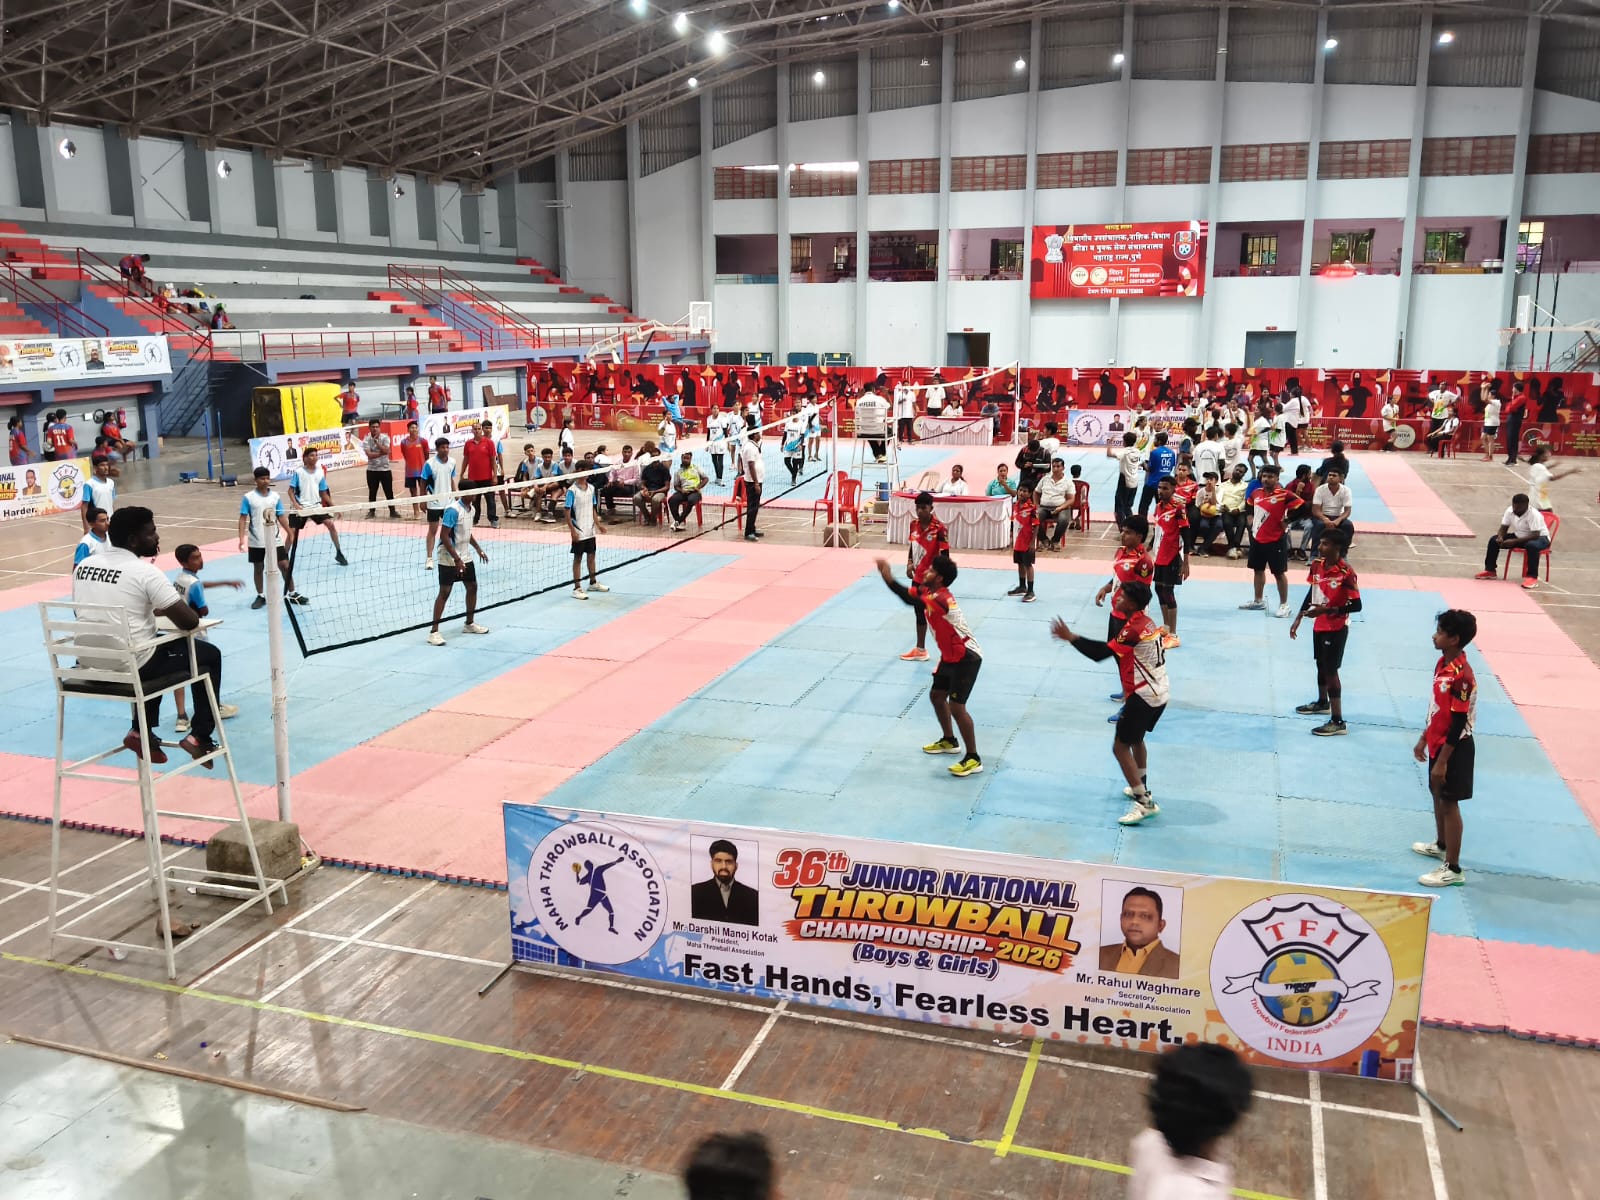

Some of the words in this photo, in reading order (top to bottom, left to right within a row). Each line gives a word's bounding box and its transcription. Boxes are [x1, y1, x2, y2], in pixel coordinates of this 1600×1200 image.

[1161, 457, 1172, 467] 06
[3, 507, 37, 517] Harder.
[76, 566, 122, 584] REFEREE
[540, 832, 616, 881] THROWBALL
[618, 843, 661, 941] ASSOCIATION
[773, 849, 850, 888] 36th
[842, 862, 940, 894] JUNIOR
[941, 871, 1078, 910] NATIONAL
[540, 886, 569, 931] MAHA
[792, 886, 1080, 952] THROWBALL
[687, 941, 702, 949] Maha
[703, 943, 731, 953] Throwball
[731, 946, 765, 957] Association
[688, 923, 720, 935] Darshil
[722, 927, 750, 941] Manoj
[752, 931, 778, 943] Kotak
[799, 921, 994, 956] CHAMPIONSHIP-
[996, 941, 1064, 971] 2026
[852, 942, 911, 968] (Boys
[914, 954, 933, 970] &
[938, 954, 999, 981] Girls)
[684, 953, 753, 985] Fast
[765, 964, 882, 1010] Hands,
[895, 983, 1050, 1027] Fearless
[1063, 1005, 1183, 1045] Heart.
[1076, 973, 1094, 984] Mr.
[1098, 976, 1132, 989] Rahul
[1136, 981, 1200, 997] Waghmare
[1084, 995, 1105, 1004] Maha
[1107, 998, 1143, 1009] Throwball
[1145, 1003, 1191, 1015] Association
[1250, 998, 1281, 1028] Throwball
[1279, 1025, 1324, 1036] Federation
[1266, 1036, 1323, 1056] INDIA
